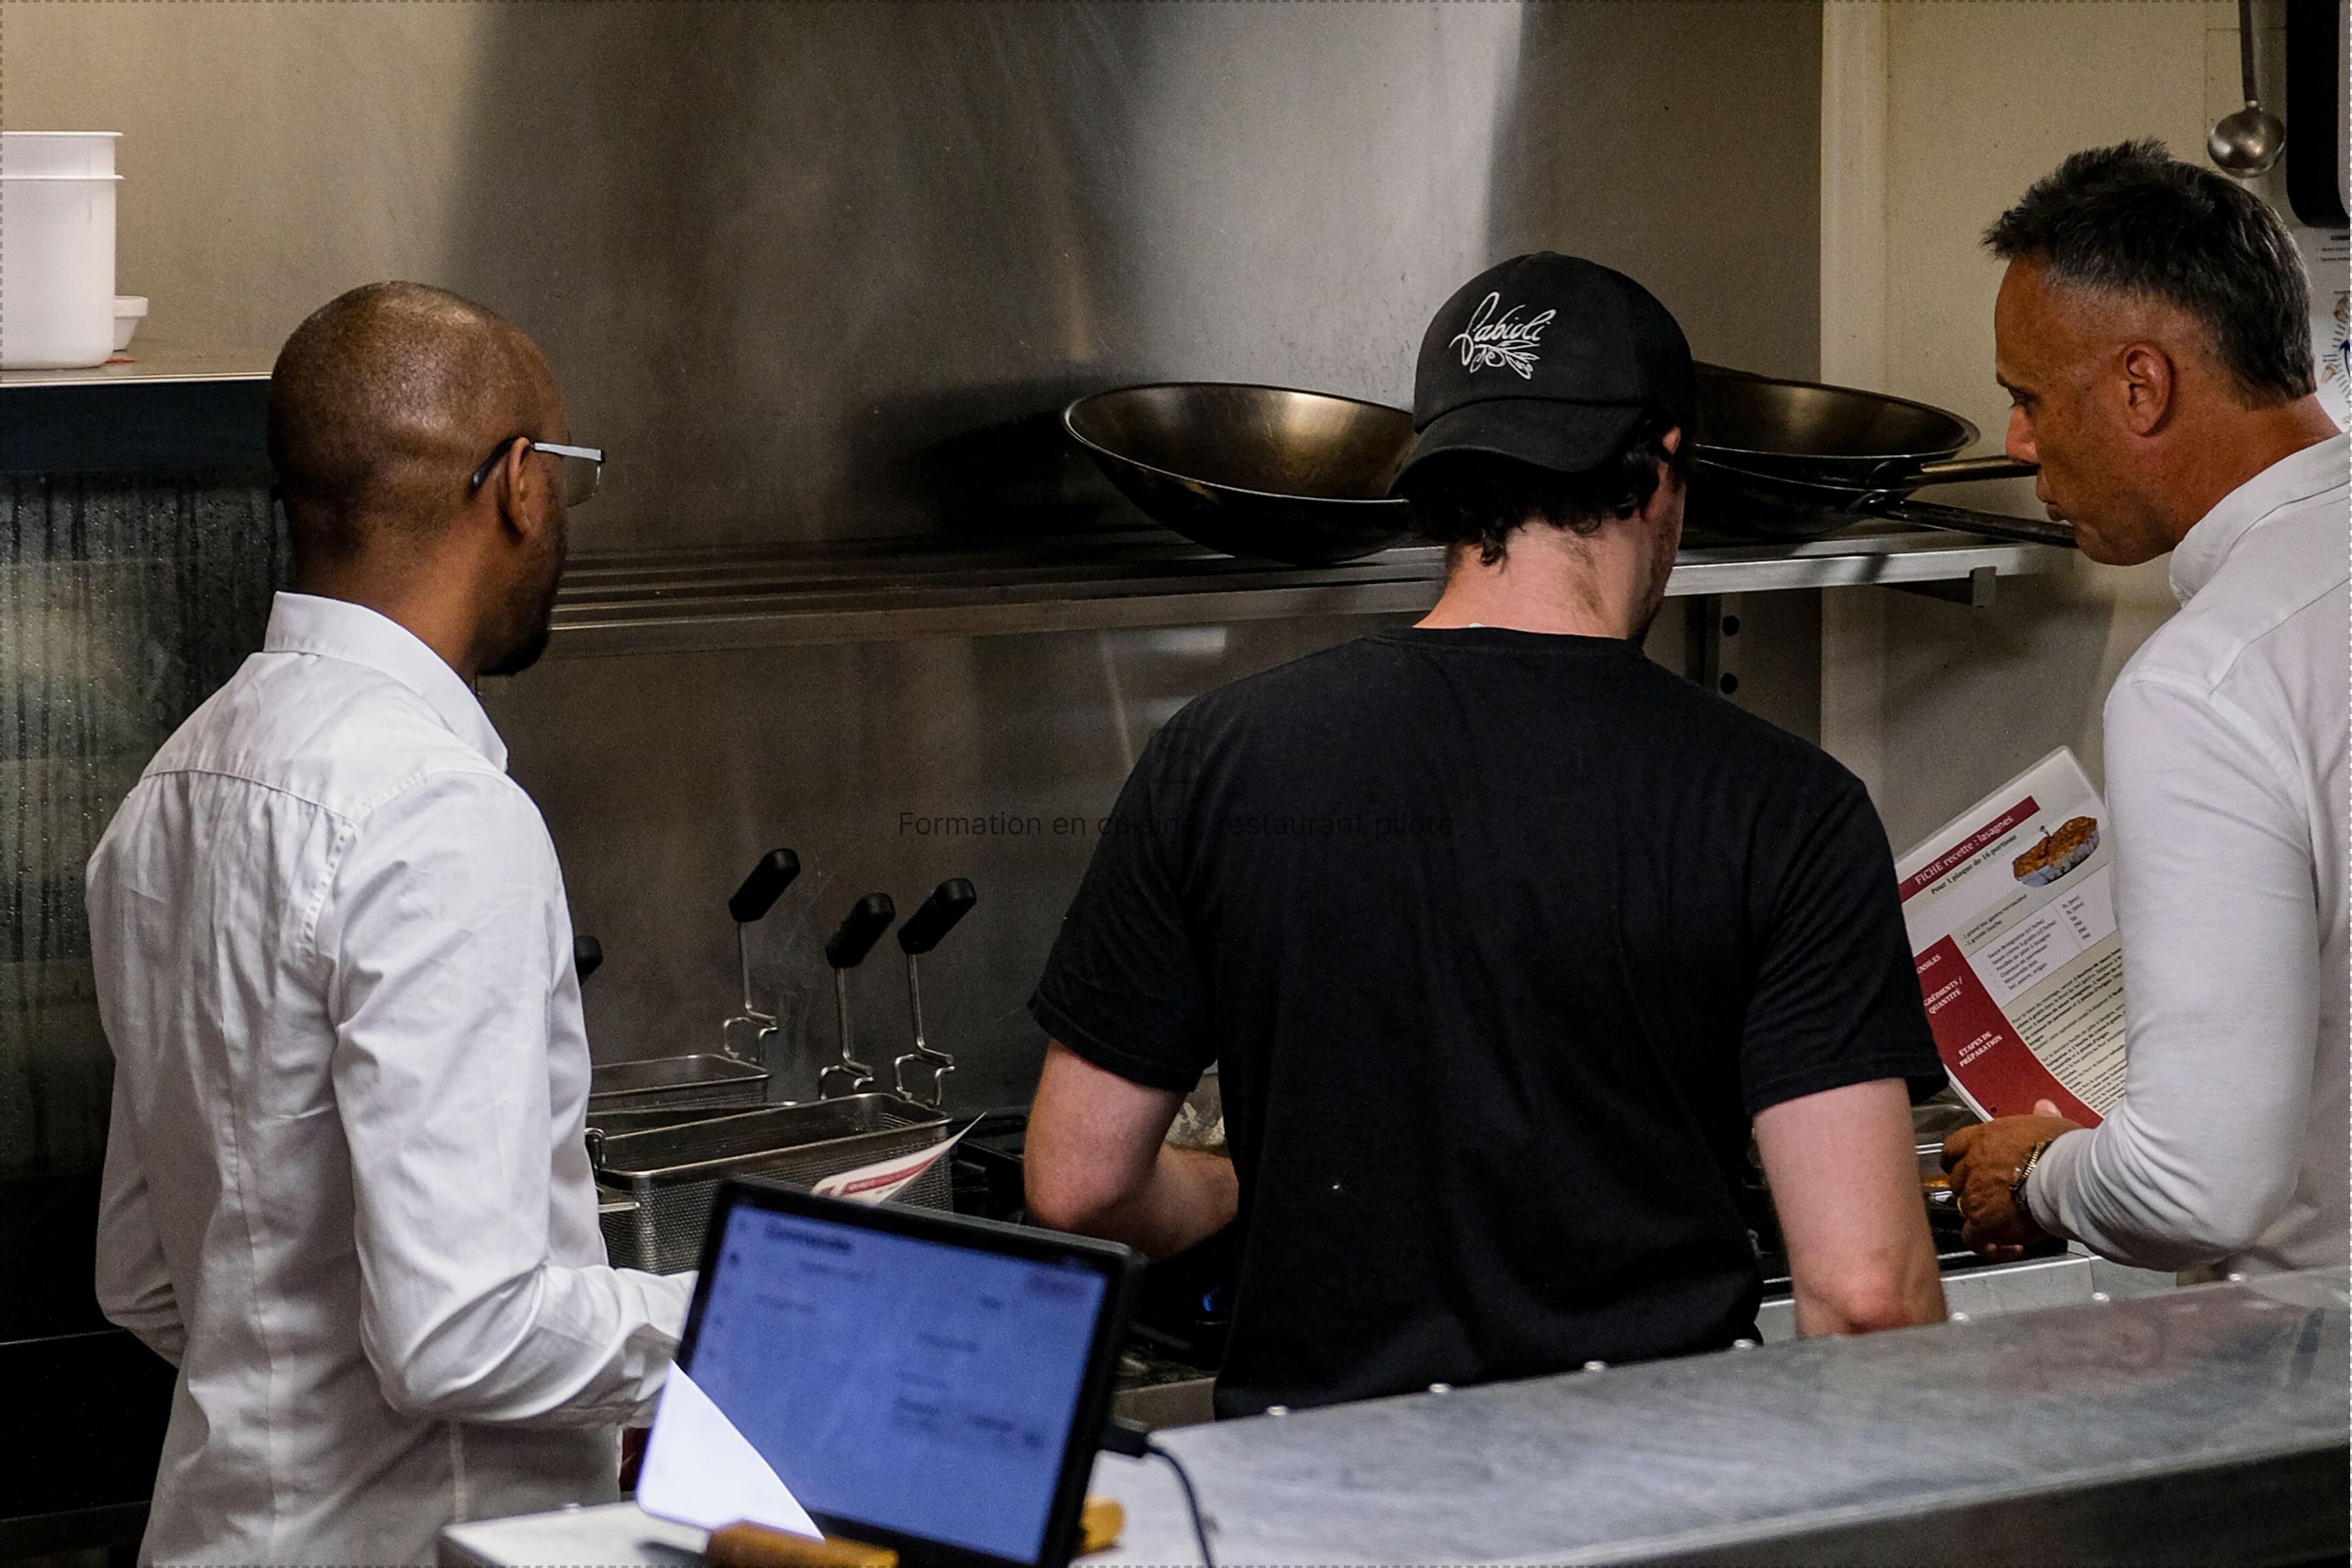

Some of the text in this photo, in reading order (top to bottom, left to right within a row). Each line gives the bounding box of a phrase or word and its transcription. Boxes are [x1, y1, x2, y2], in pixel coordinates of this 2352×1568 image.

[1915, 862, 1943, 884] FICHE
[1943, 842, 1973, 865] recette
[1977, 814, 2013, 843] lasagnes
[1972, 857, 1981, 866] de
[1923, 979, 1958, 1006] GRÉDIENTS
[1928, 988, 1961, 1014] QUANTITÉ
[1959, 1030, 1992, 1056] ÉTAPES DE
[1959, 1033, 2002, 1067] PRÉPARATION
